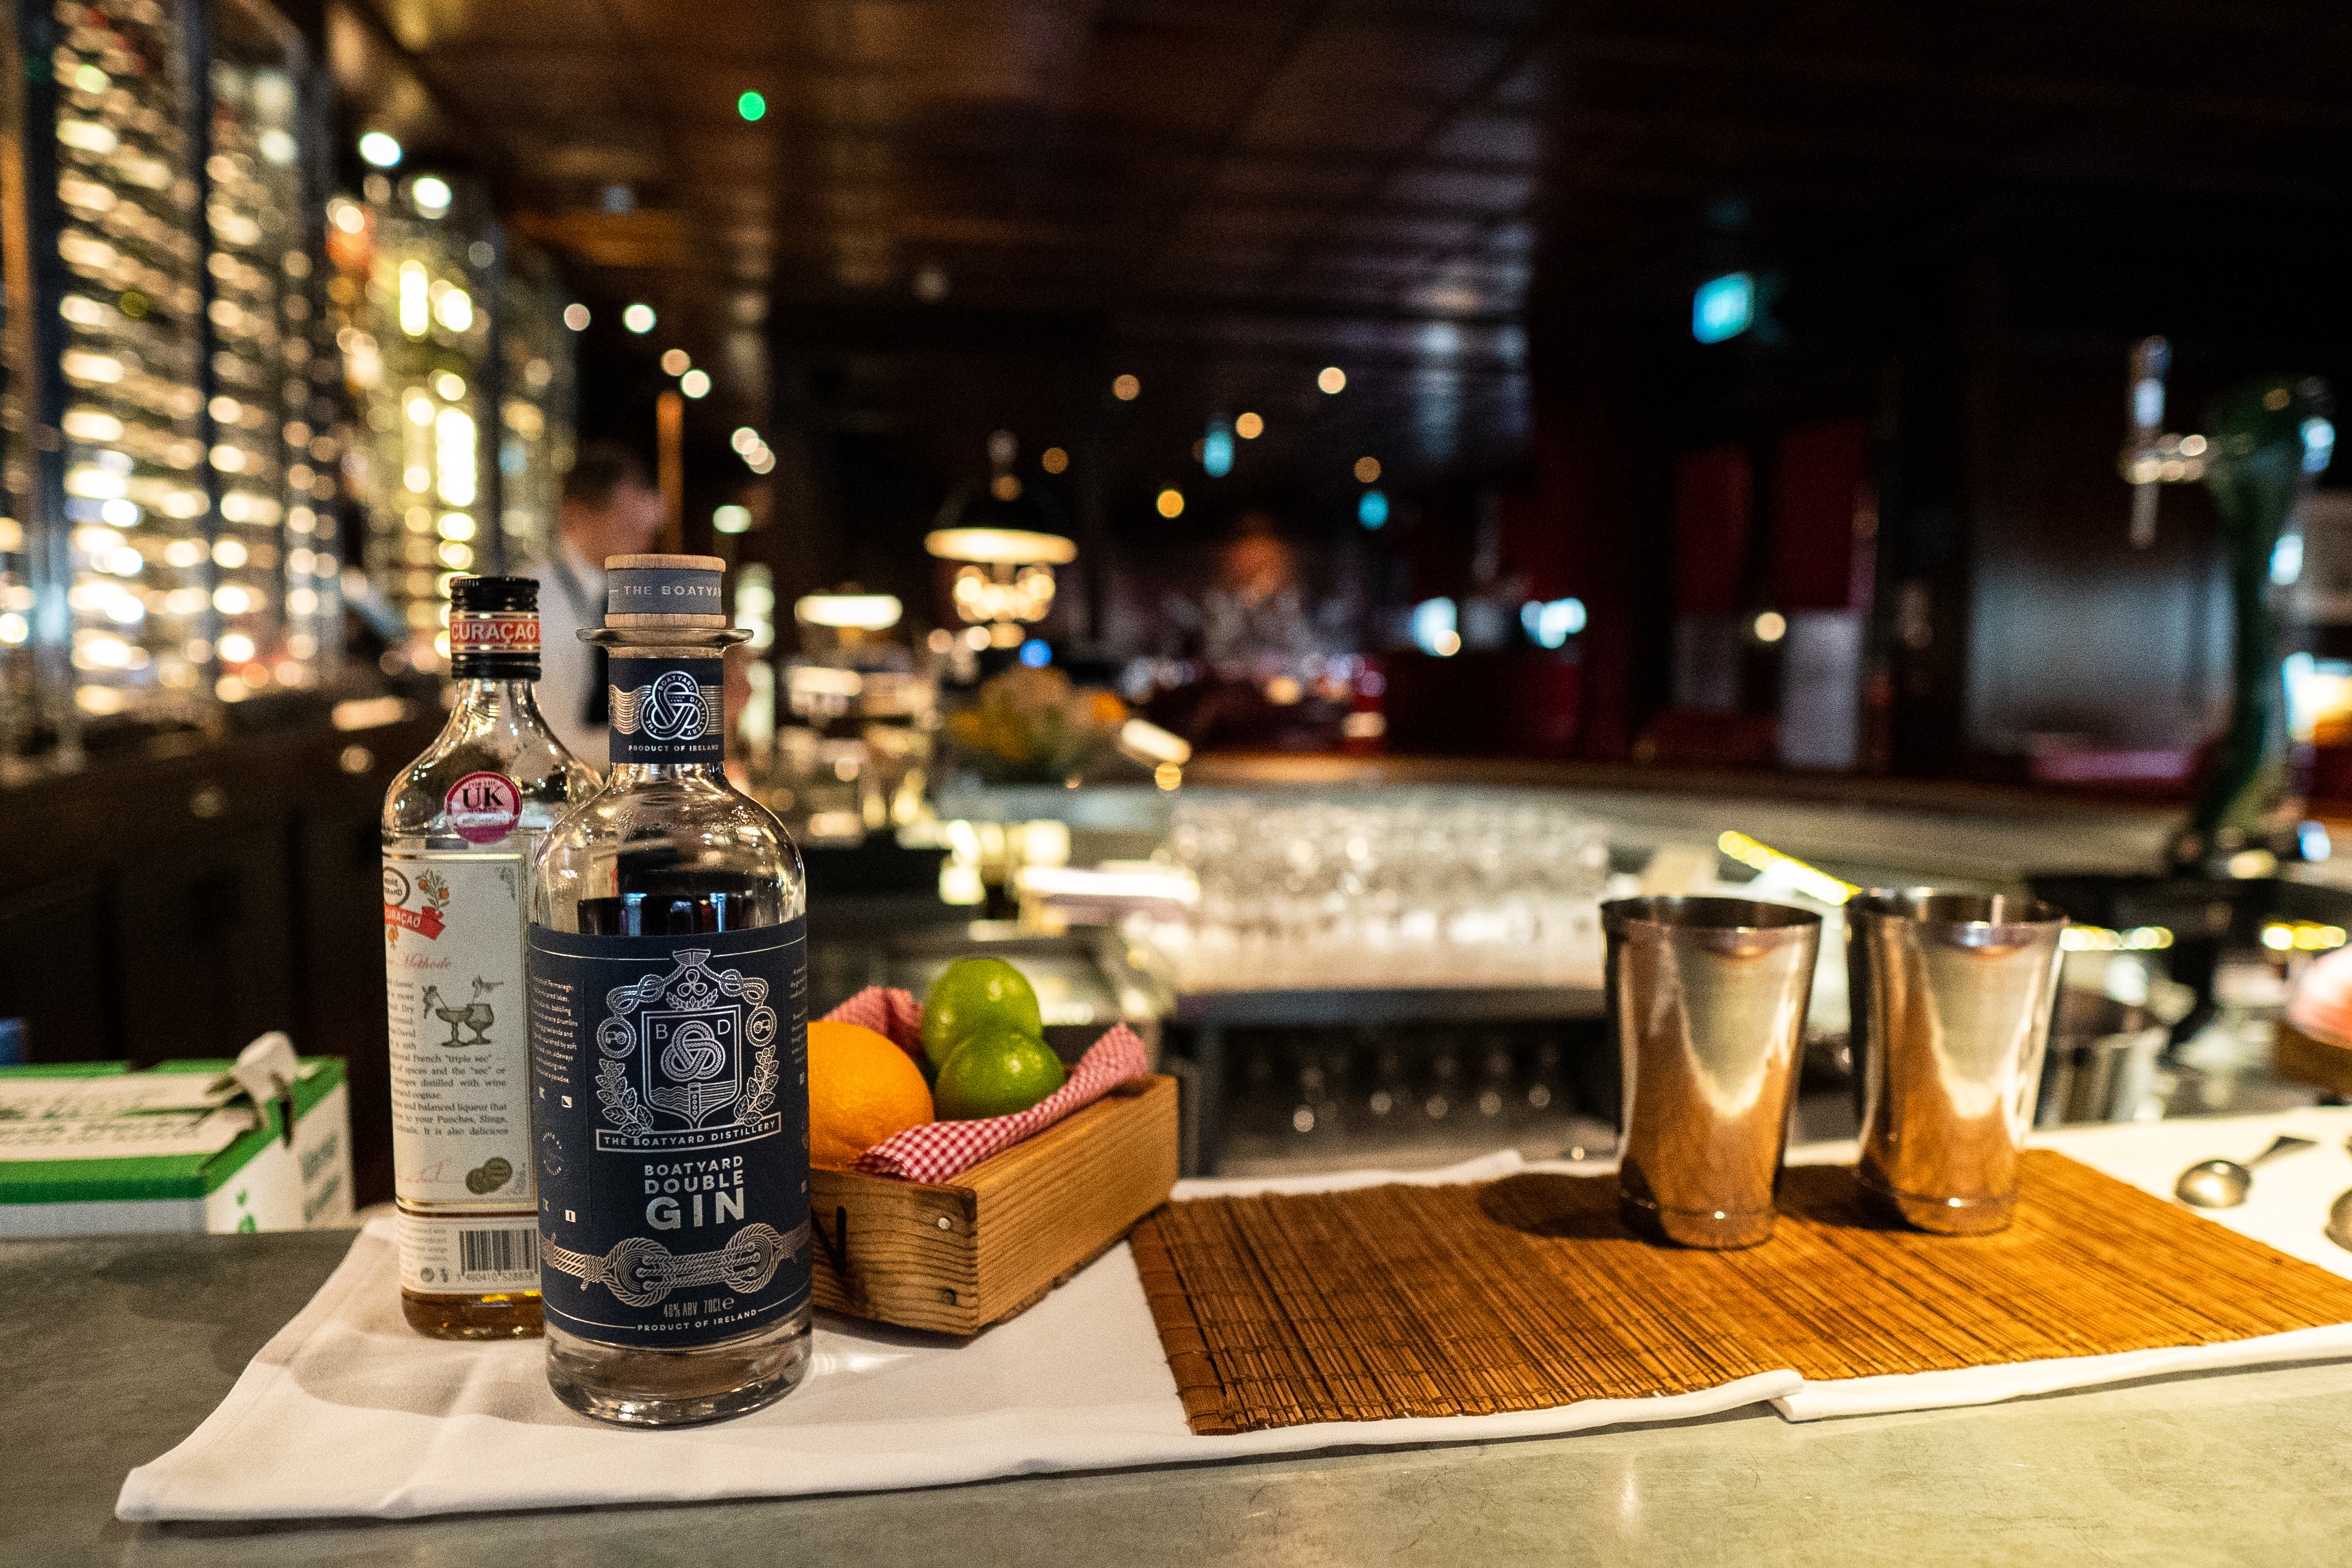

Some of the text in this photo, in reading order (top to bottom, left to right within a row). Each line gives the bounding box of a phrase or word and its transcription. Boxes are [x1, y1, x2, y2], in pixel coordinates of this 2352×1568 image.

[623, 586, 652, 595] THE
[452, 623, 536, 643] CURAÇAO
[658, 675, 694, 691] BOATYARD
[687, 696, 706, 736] DISTILLERY
[462, 786, 504, 808] UK
[656, 1024, 668, 1039] B
[718, 1019, 730, 1035] D
[413, 1054, 441, 1062] French
[421, 1079, 454, 1088] distilled
[460, 1079, 479, 1088] with
[418, 1103, 455, 1111] balanced
[457, 1103, 487, 1113] liqueur
[490, 1103, 507, 1111] that
[604, 1120, 776, 1146] THE BOATYARD DISTILLERY
[645, 1156, 743, 1176] BOATYARD
[645, 1170, 743, 1194] DOUBLE
[646, 1187, 744, 1230] GIN
[663, 1303, 680, 1318] 46%
[682, 1301, 698, 1316] ABV
[637, 1322, 689, 1331] PRODUCT
[713, 1309, 757, 1325] IRELAND
